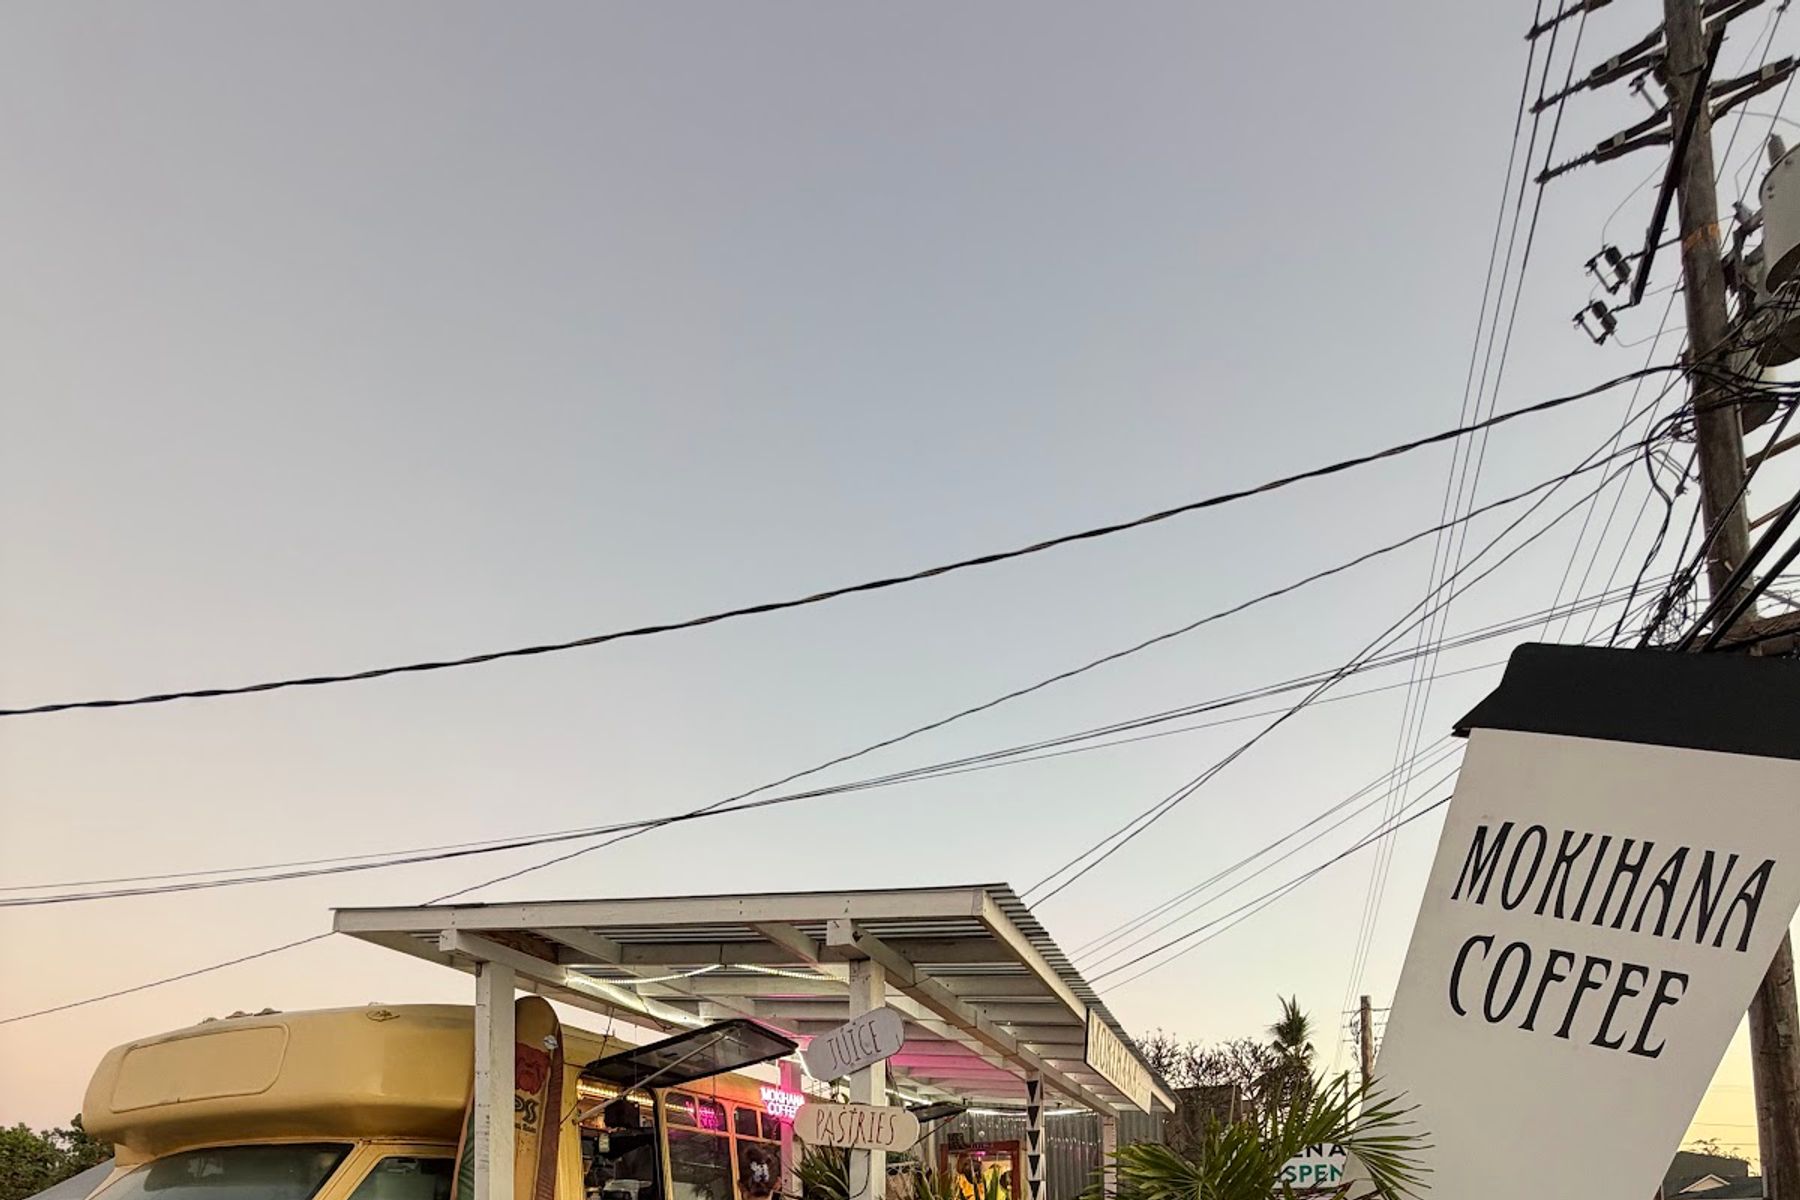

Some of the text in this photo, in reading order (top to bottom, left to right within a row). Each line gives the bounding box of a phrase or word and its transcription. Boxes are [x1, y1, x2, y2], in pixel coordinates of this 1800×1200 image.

[1451, 822, 1776, 952] MOKIHANA
[1449, 934, 1689, 1059] COFFEE
[827, 1020, 882, 1070] JUICE
[767, 1102, 799, 1120] COFFE
[816, 1106, 896, 1145] PASTRIES
[1284, 1164, 1344, 1183] SPEN
